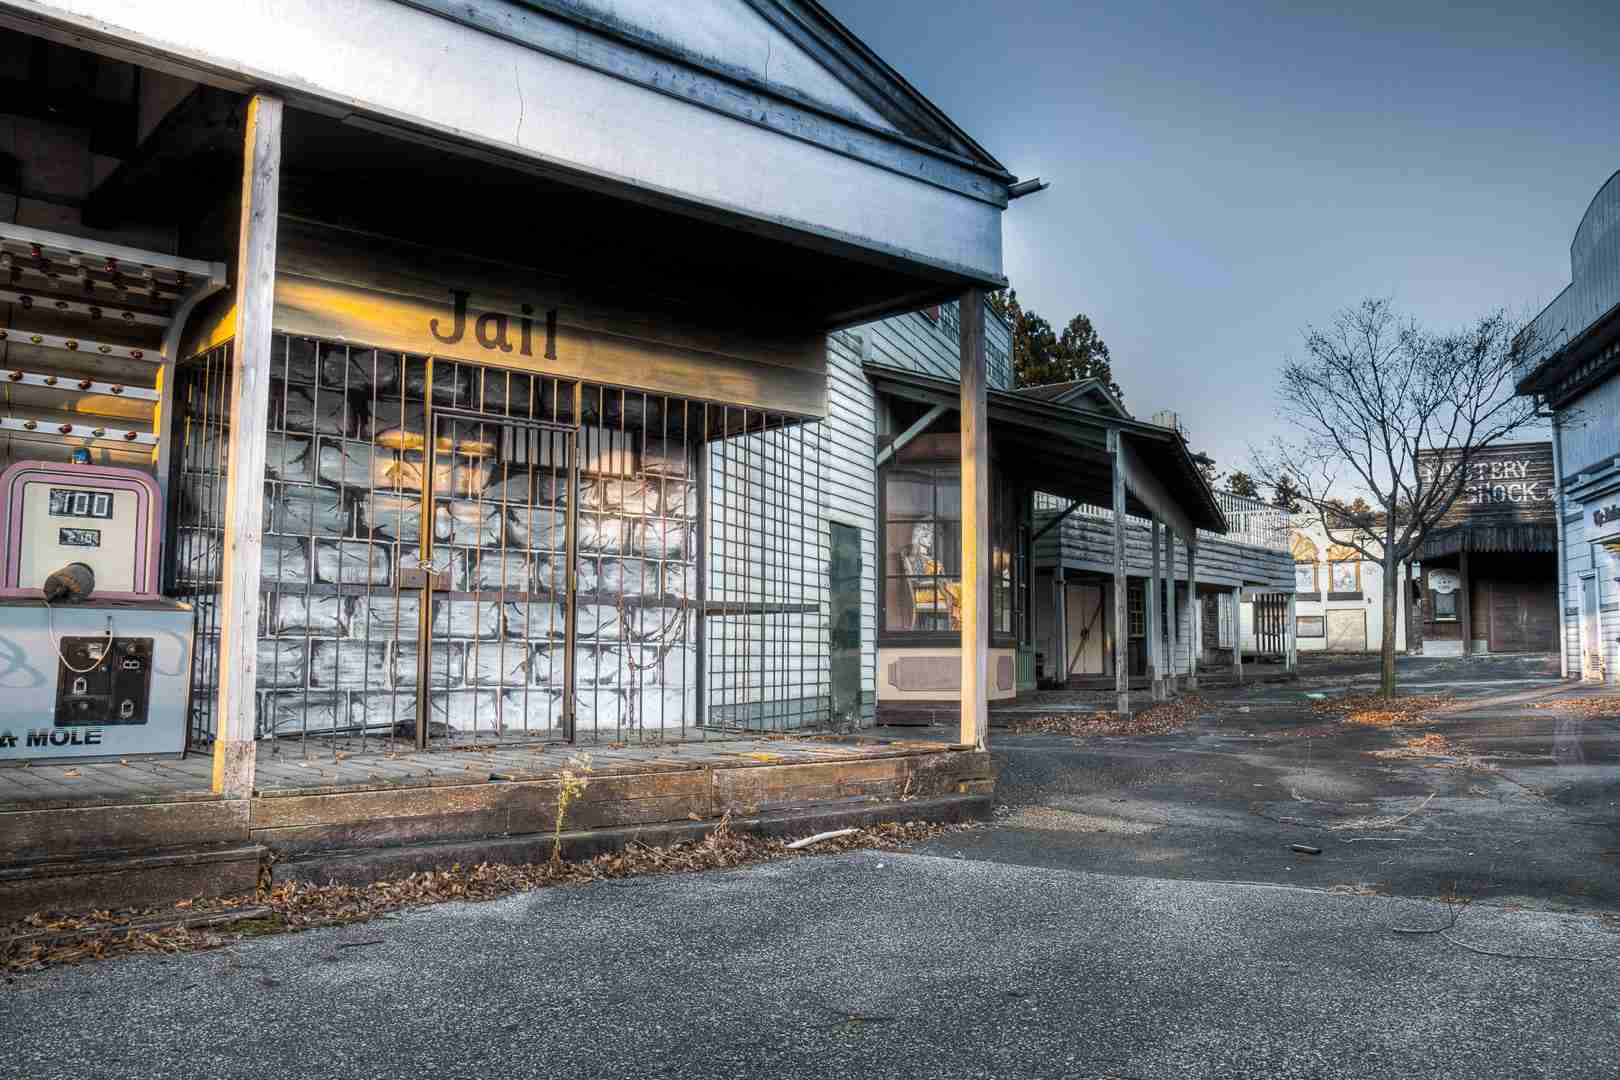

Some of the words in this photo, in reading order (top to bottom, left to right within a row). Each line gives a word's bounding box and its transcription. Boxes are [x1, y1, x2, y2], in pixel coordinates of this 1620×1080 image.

[430, 288, 557, 360] Jail
[1425, 460, 1530, 482] MTERY
[26, 728, 102, 747] MOLE
